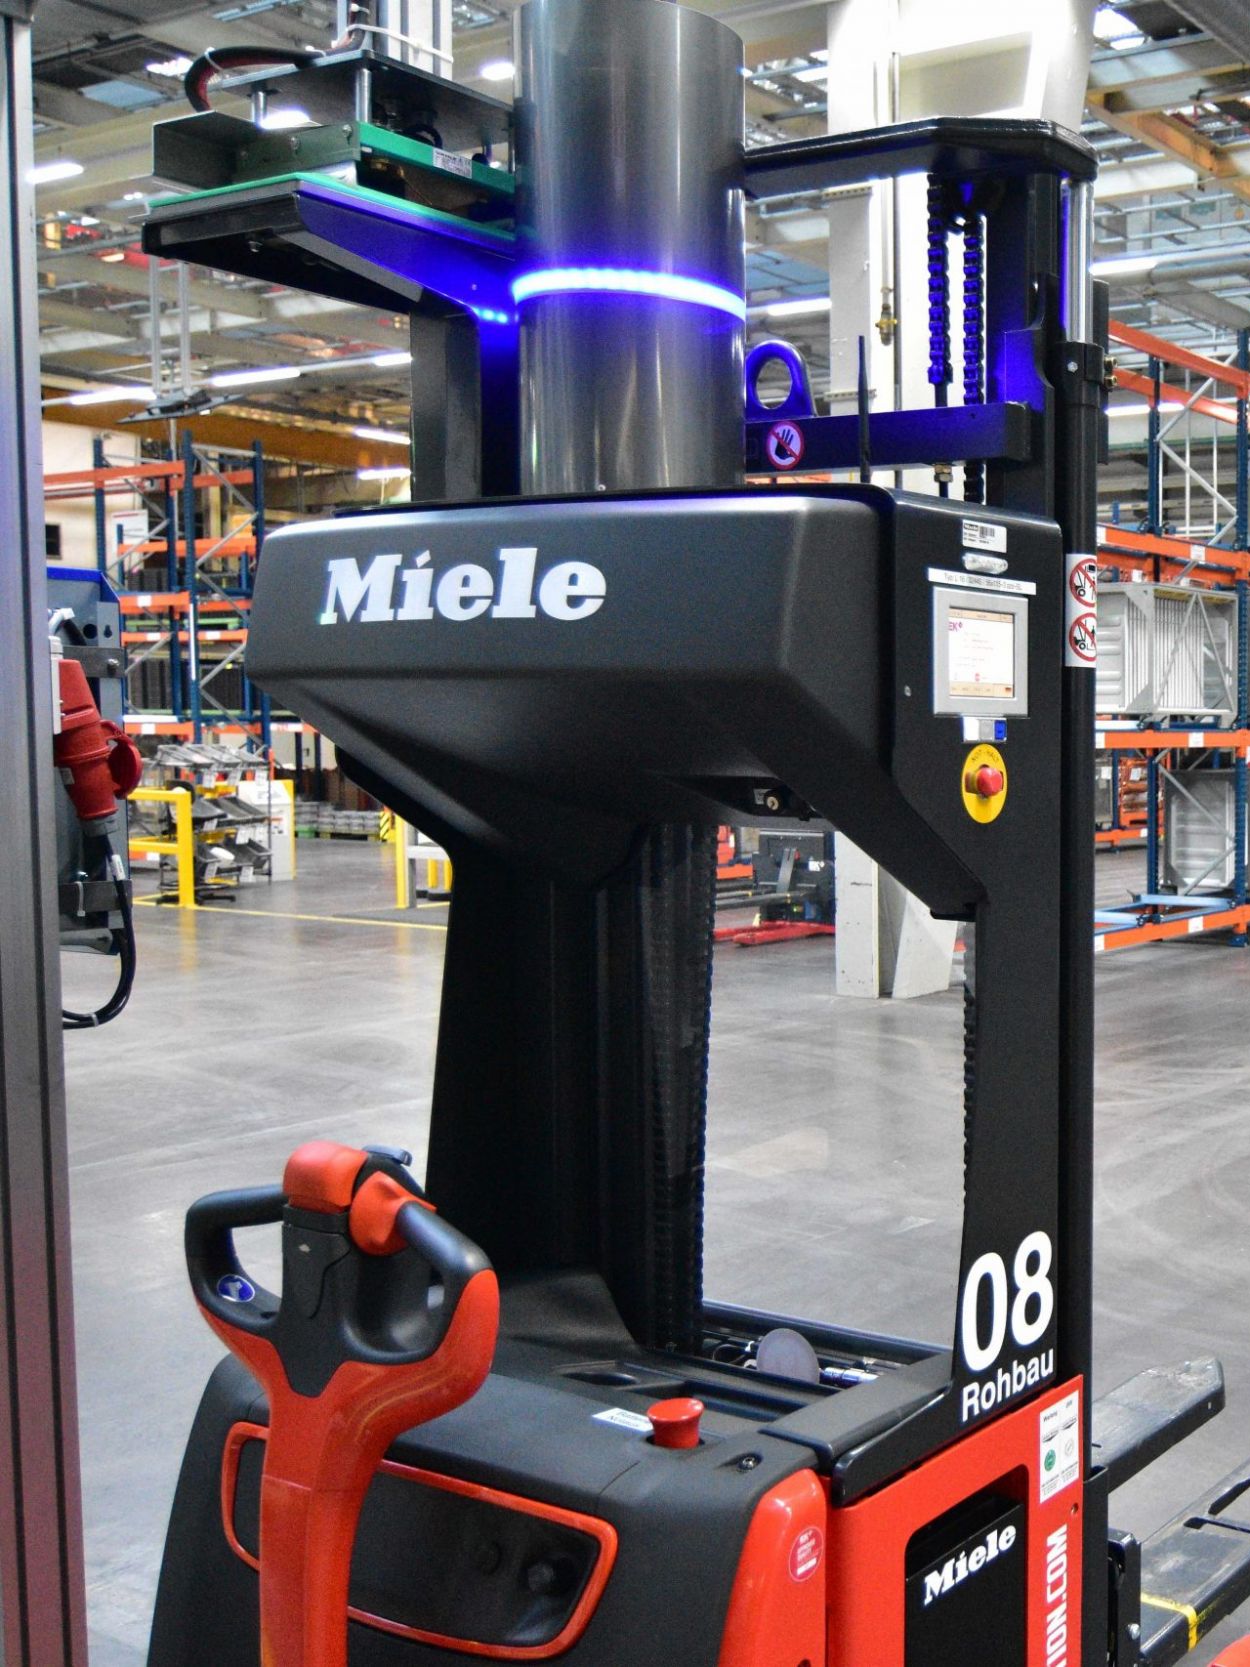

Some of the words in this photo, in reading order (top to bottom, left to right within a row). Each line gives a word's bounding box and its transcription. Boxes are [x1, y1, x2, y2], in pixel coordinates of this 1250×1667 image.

[319, 548, 607, 625] Miele
[962, 1231, 1054, 1371] 08
[962, 1348, 1054, 1422] Rohbau
[923, 1525, 1017, 1606] Miele
